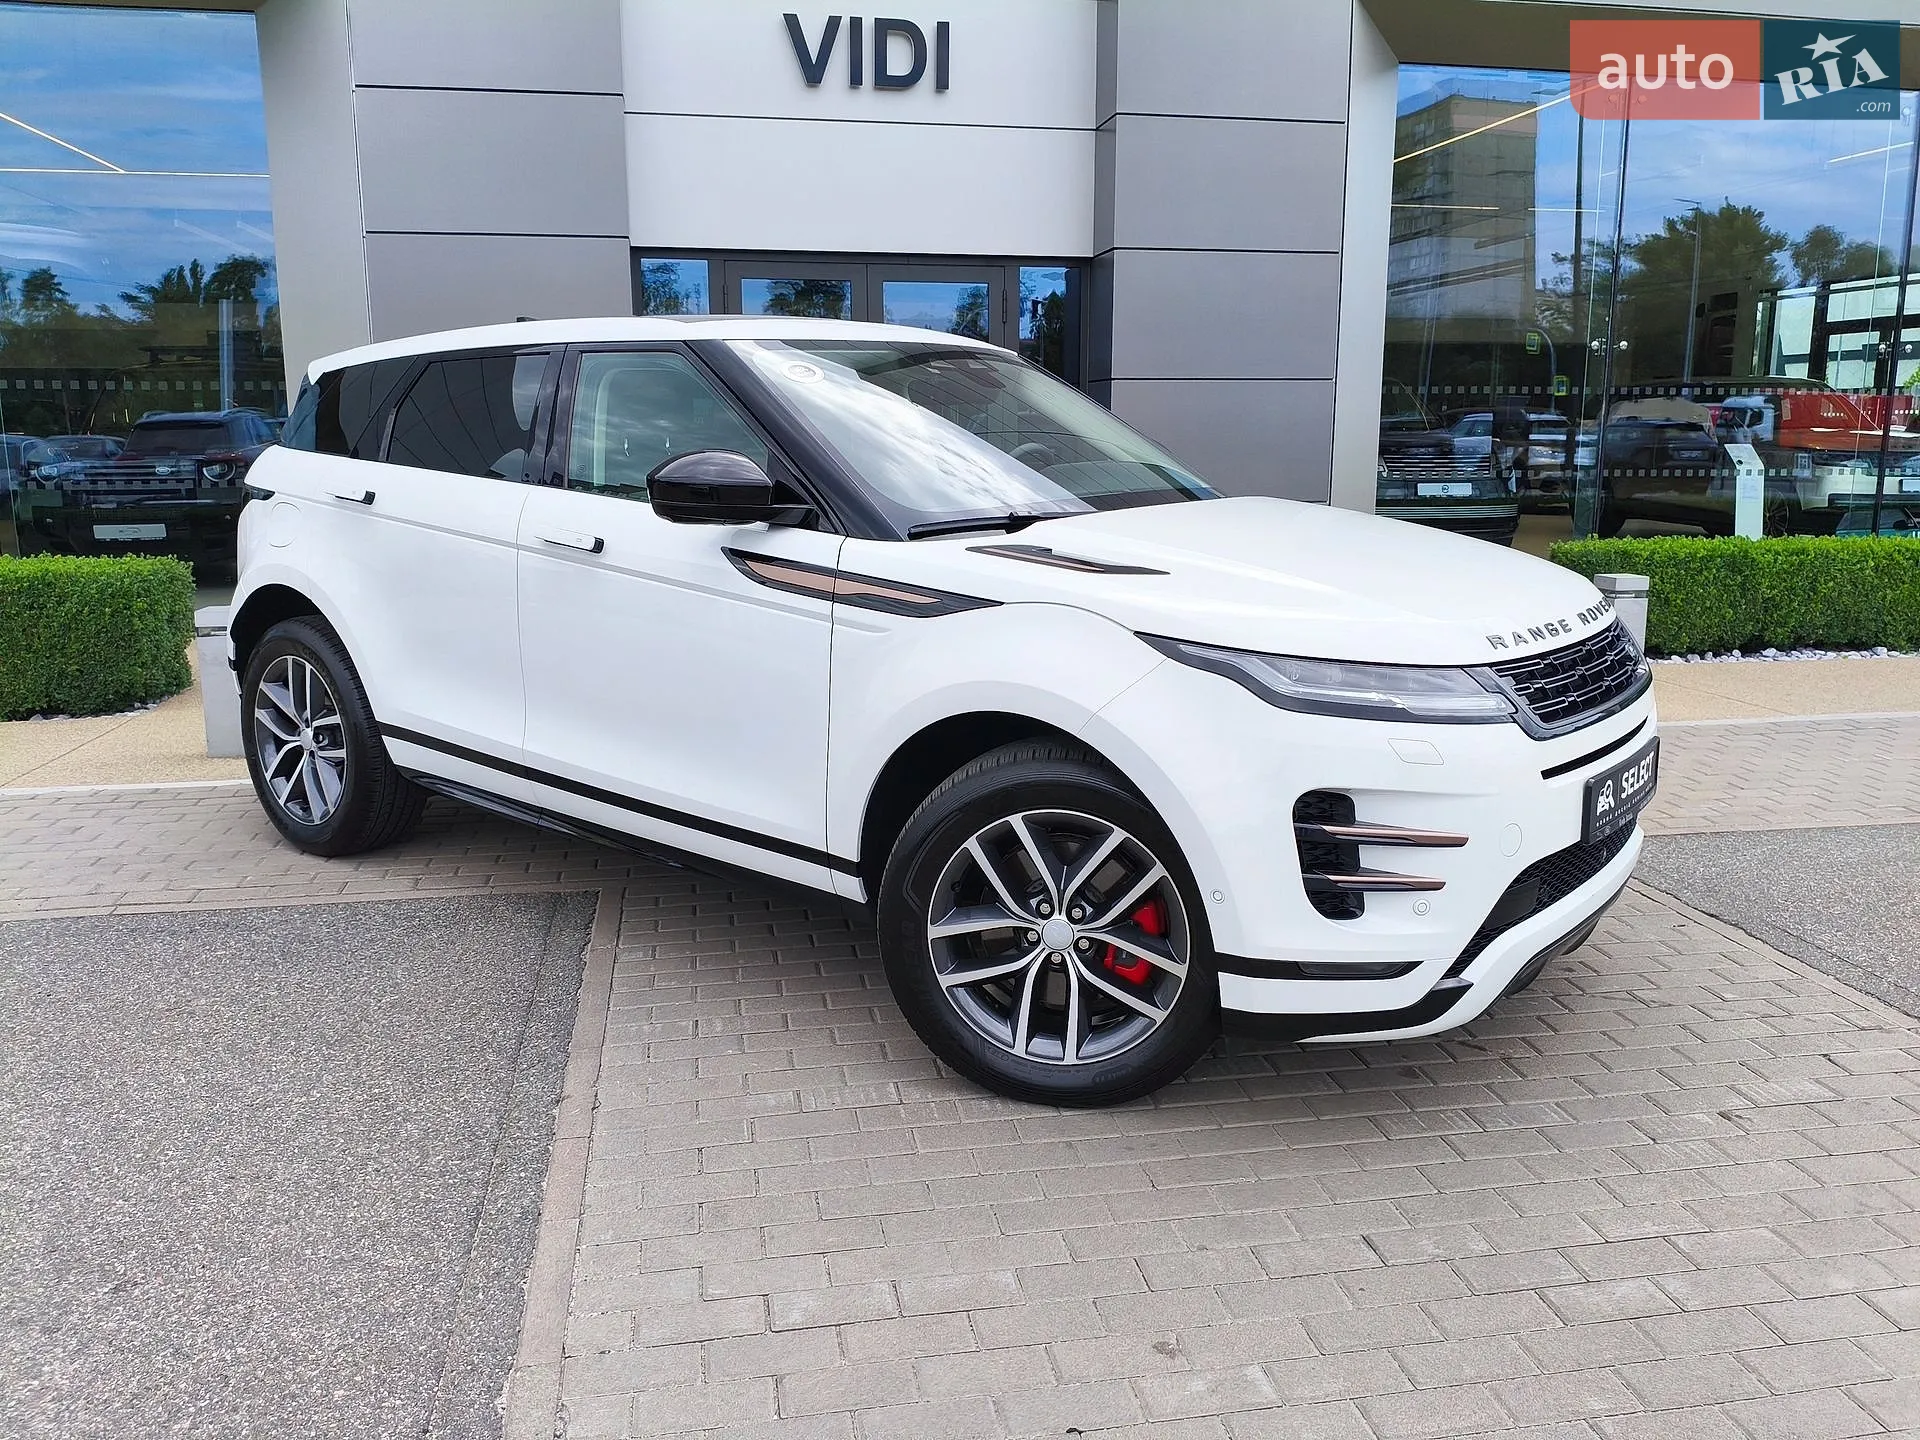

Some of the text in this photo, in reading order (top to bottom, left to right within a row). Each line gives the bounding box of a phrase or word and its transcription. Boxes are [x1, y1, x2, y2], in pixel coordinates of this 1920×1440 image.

[783, 13, 950, 92] VIDI
[1486, 618, 1572, 650] RANGE
[1621, 751, 1655, 799] SELECT
